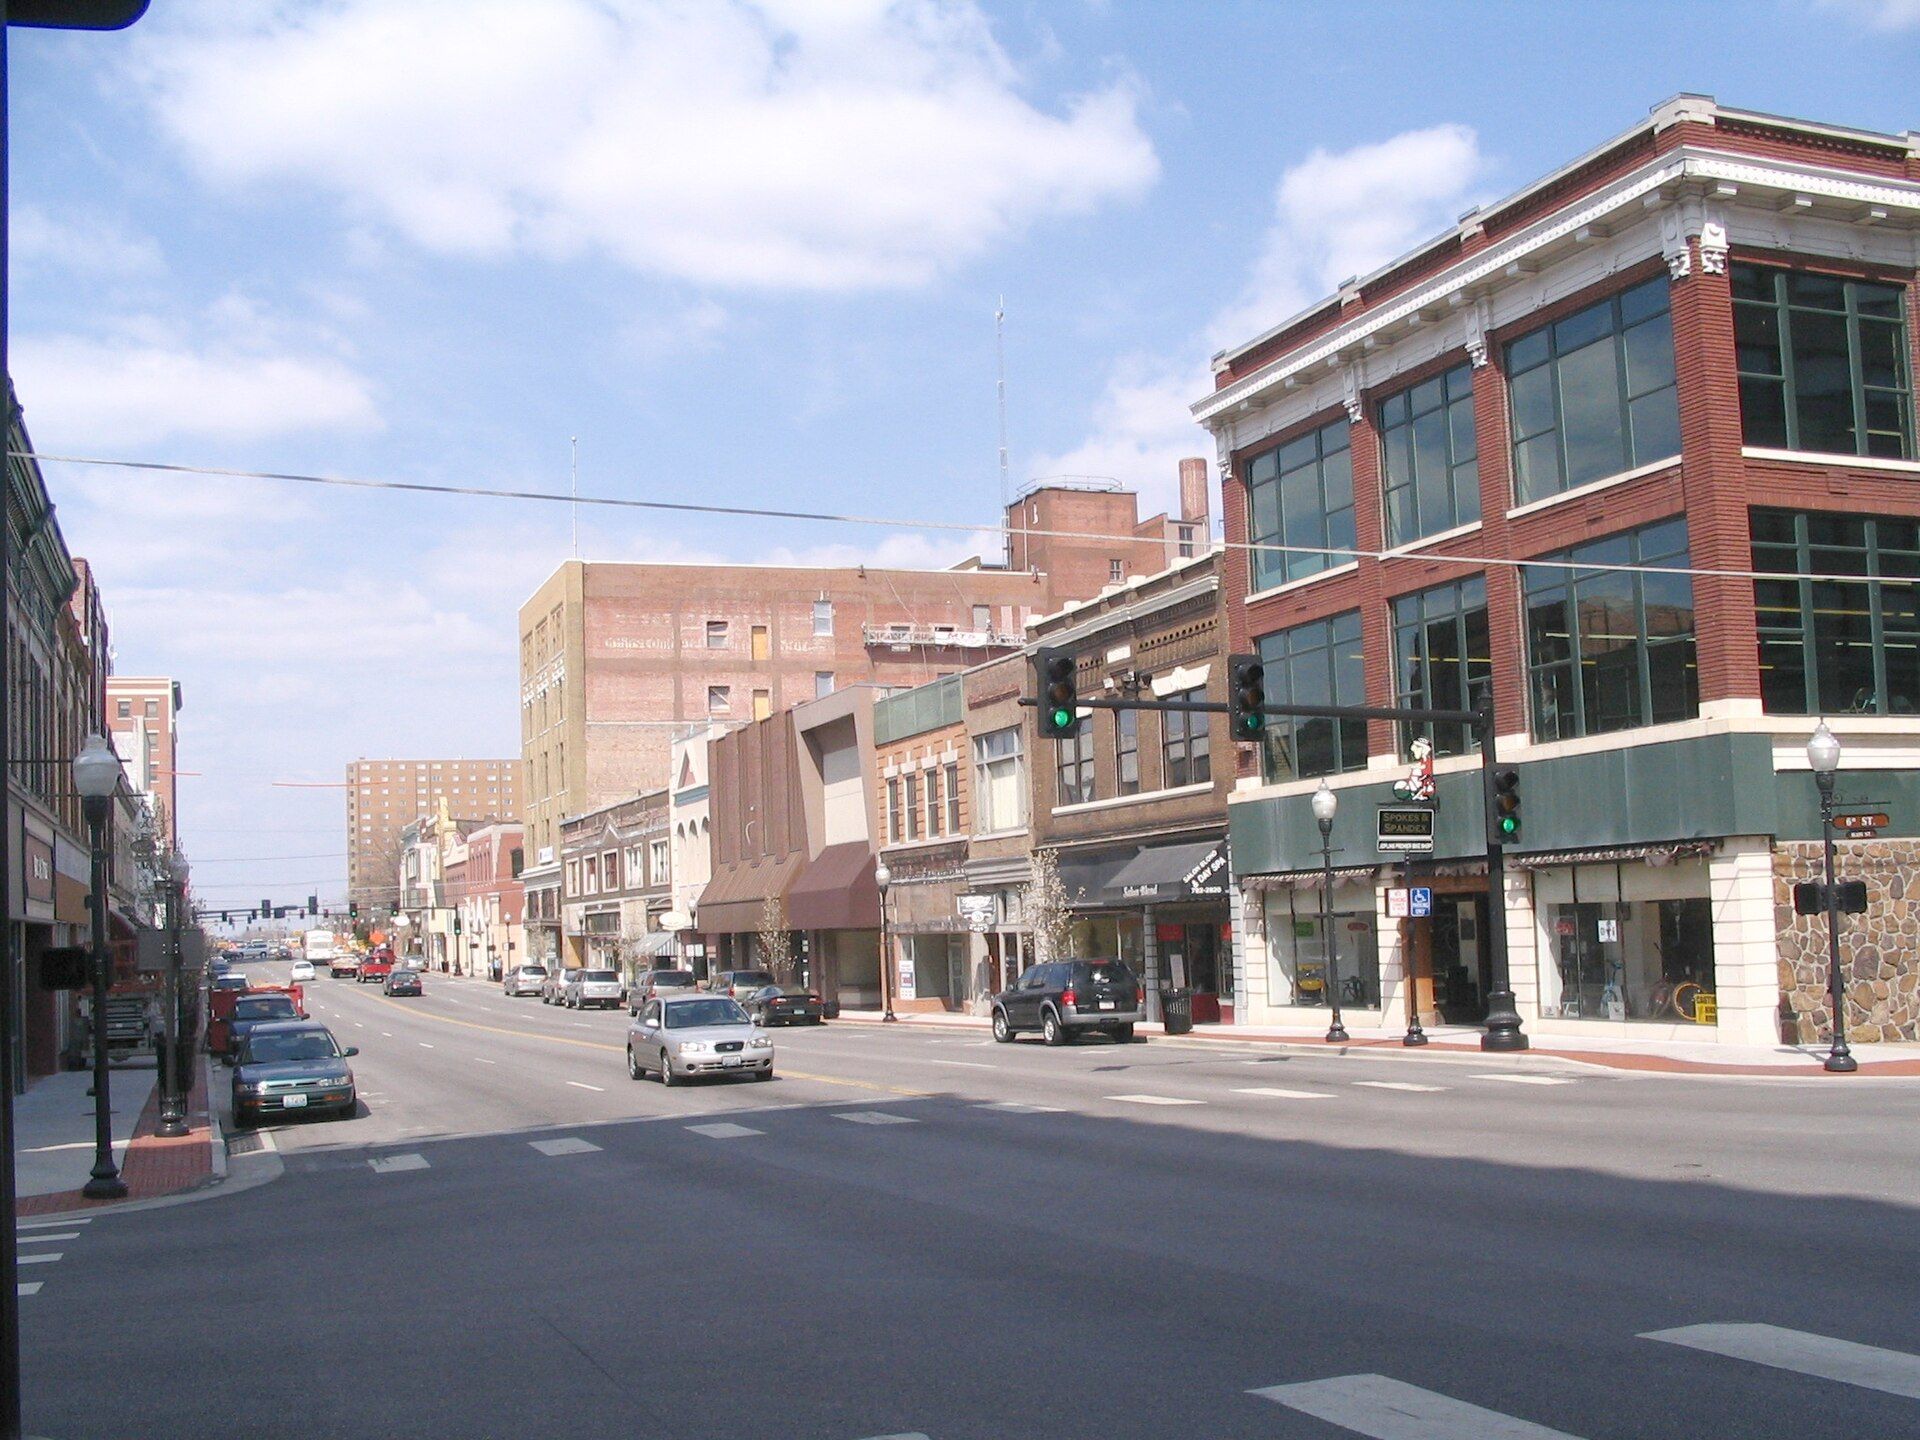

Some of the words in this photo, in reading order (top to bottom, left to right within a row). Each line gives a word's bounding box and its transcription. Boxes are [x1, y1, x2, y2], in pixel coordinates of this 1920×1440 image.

[1383, 813, 1419, 821] SPOKES
[1384, 823, 1427, 832] SPANDEX
[1182, 865, 1201, 884] SALON
[1200, 849, 1218, 868] BLOND
[1191, 879, 1200, 888] &
[1197, 866, 1213, 884] DAY
[1210, 856, 1227, 872] SPA
